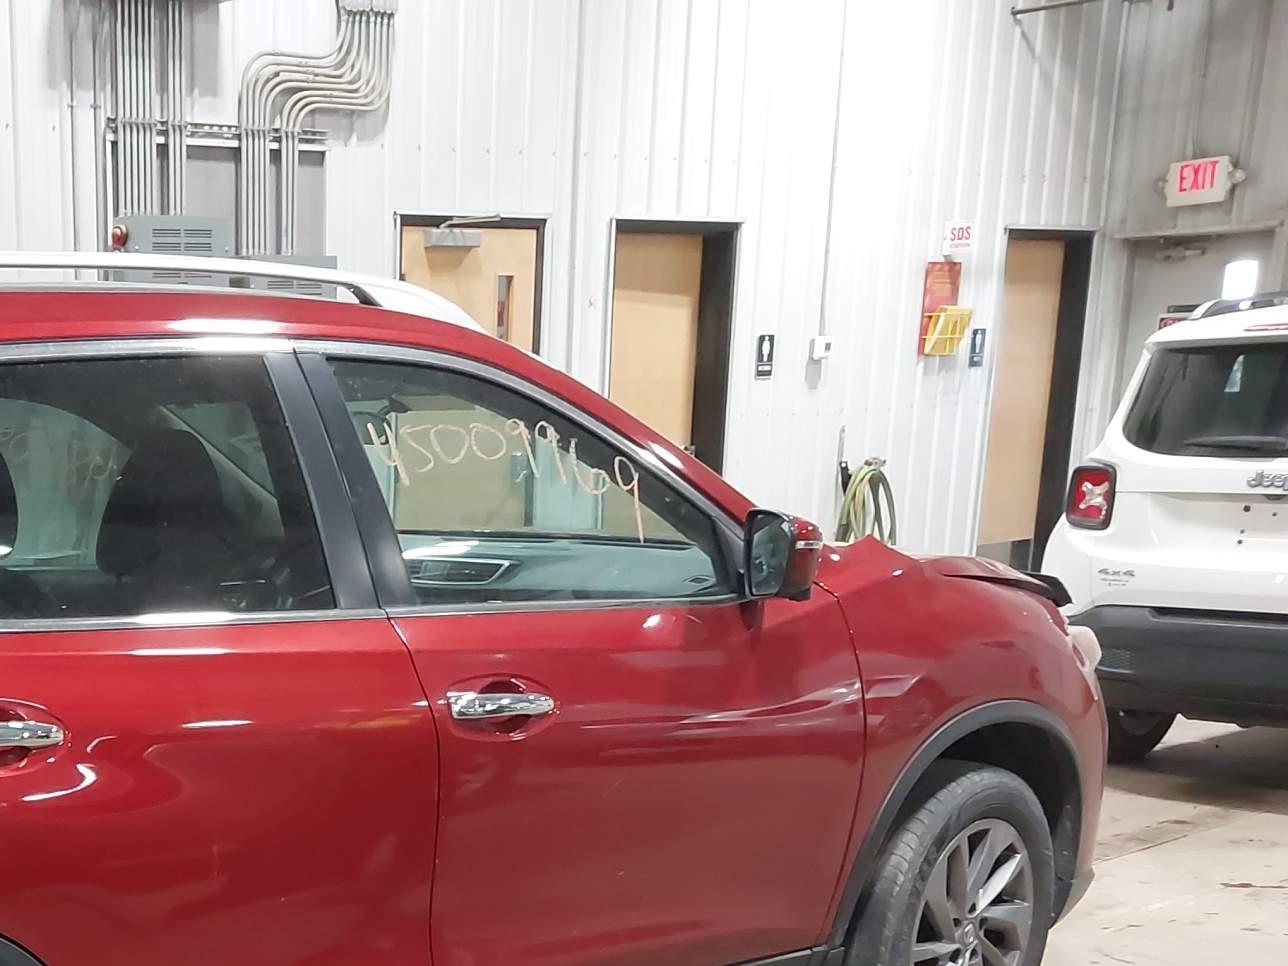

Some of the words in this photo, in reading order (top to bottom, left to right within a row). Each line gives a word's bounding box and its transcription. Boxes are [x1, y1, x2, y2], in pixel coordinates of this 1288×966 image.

[1178, 160, 1219, 192] EXIT
[950, 226, 971, 241] SDS
[367, 418, 645, 543] 45009969
